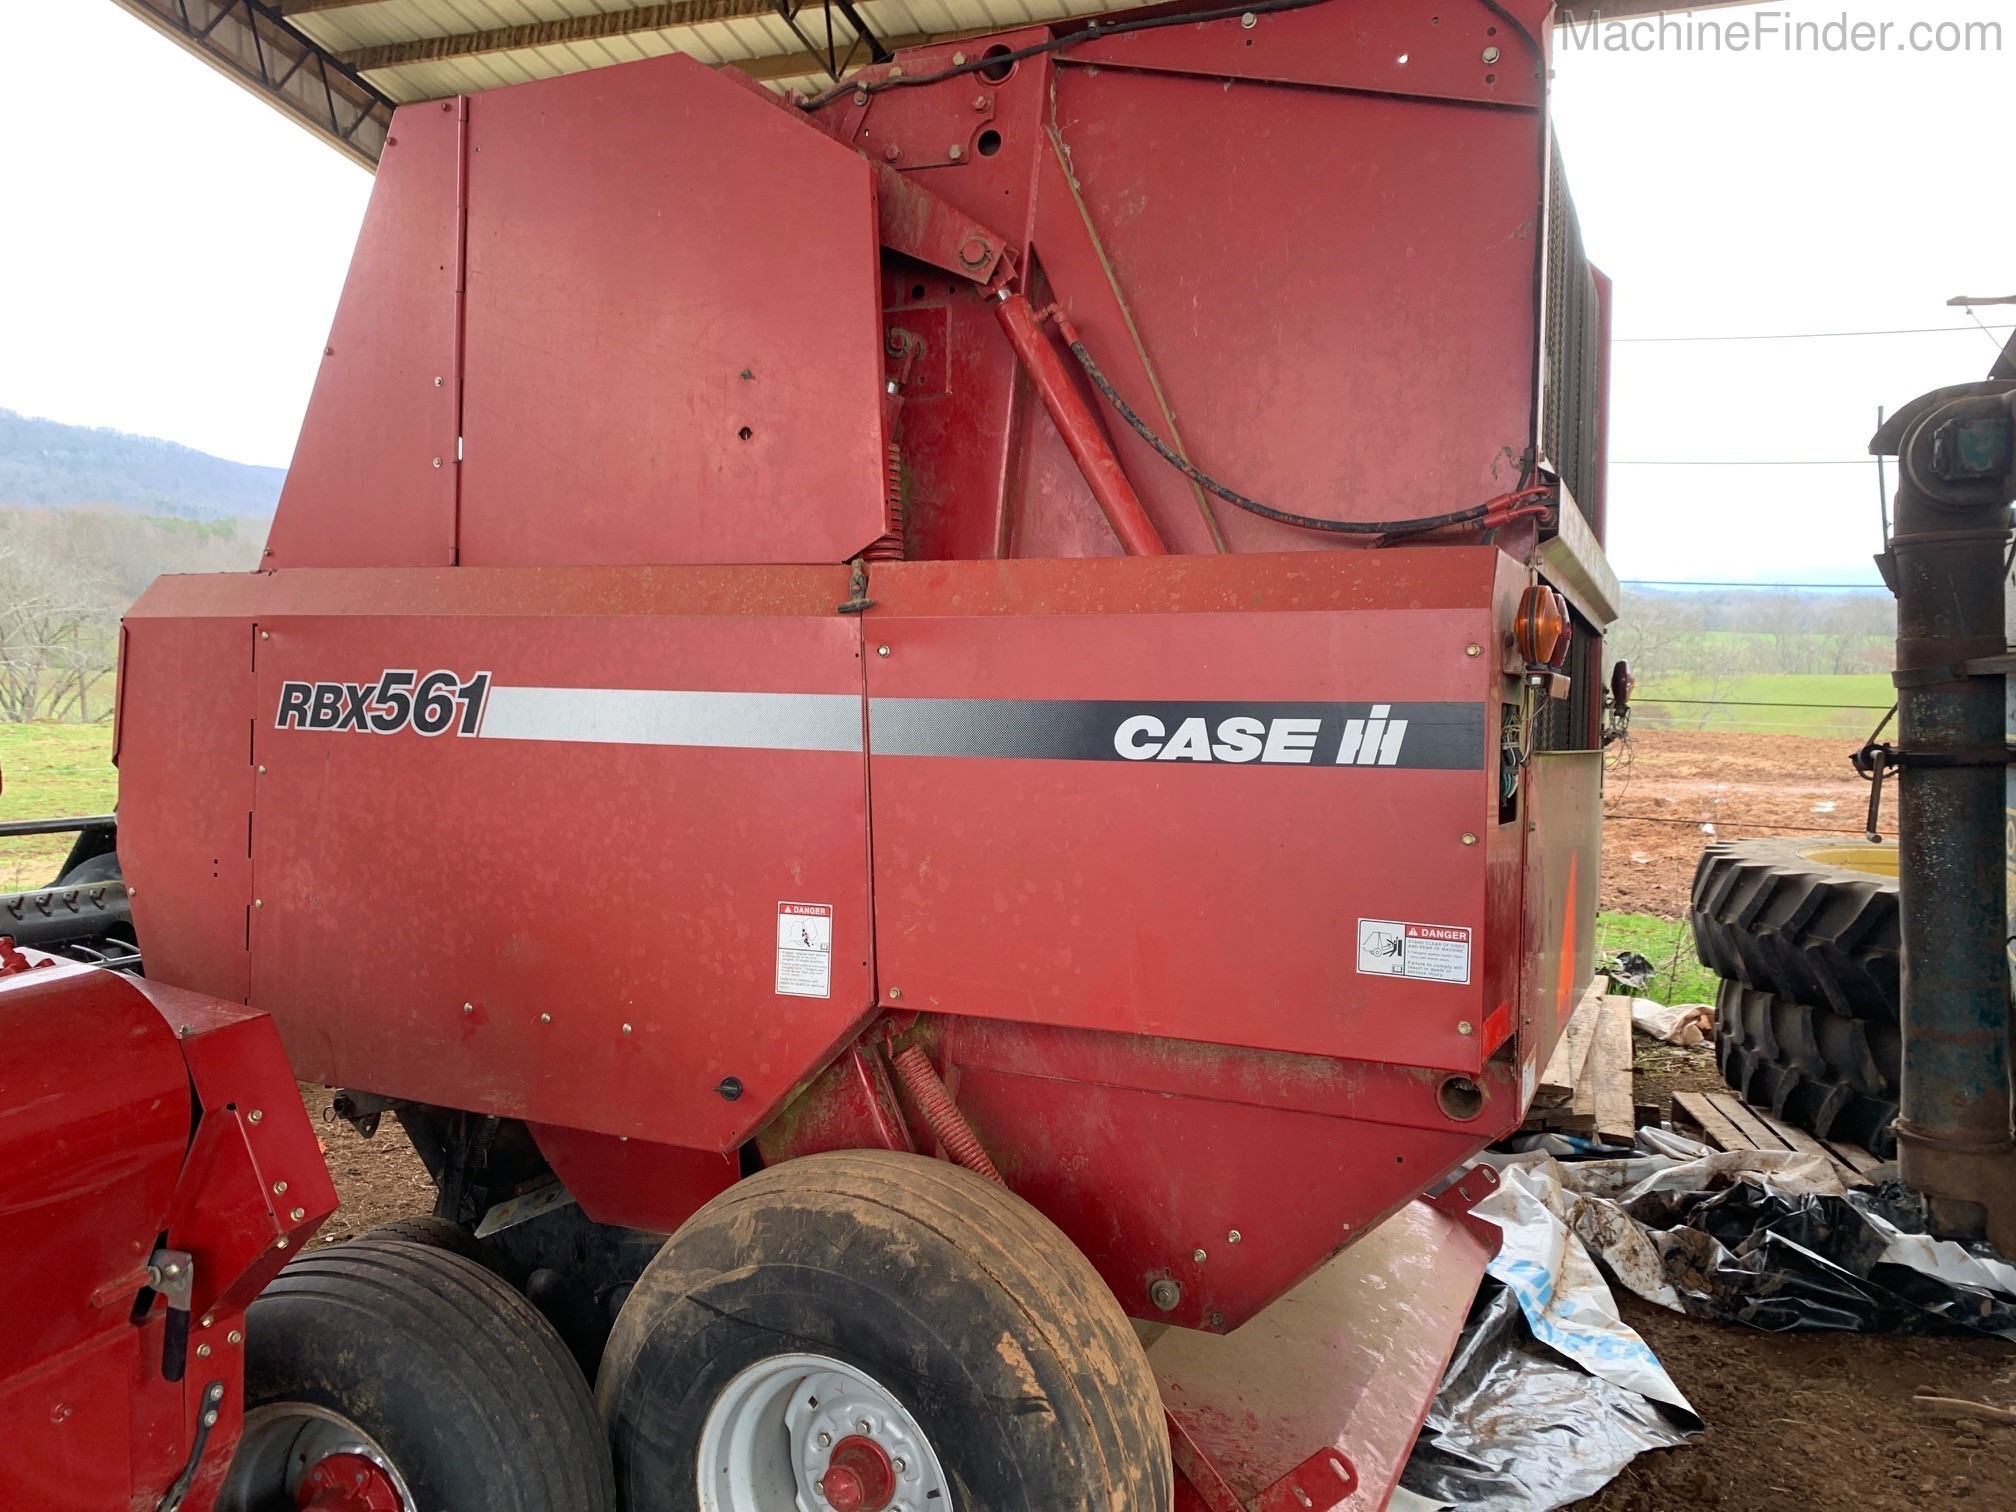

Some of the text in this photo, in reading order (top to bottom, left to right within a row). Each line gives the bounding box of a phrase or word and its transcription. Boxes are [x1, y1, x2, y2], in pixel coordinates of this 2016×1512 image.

[274, 669, 492, 737] RBX561
[1113, 714, 1322, 763] CASE
[793, 905, 826, 915] DANGER
[1421, 928, 1467, 940] DANGER
